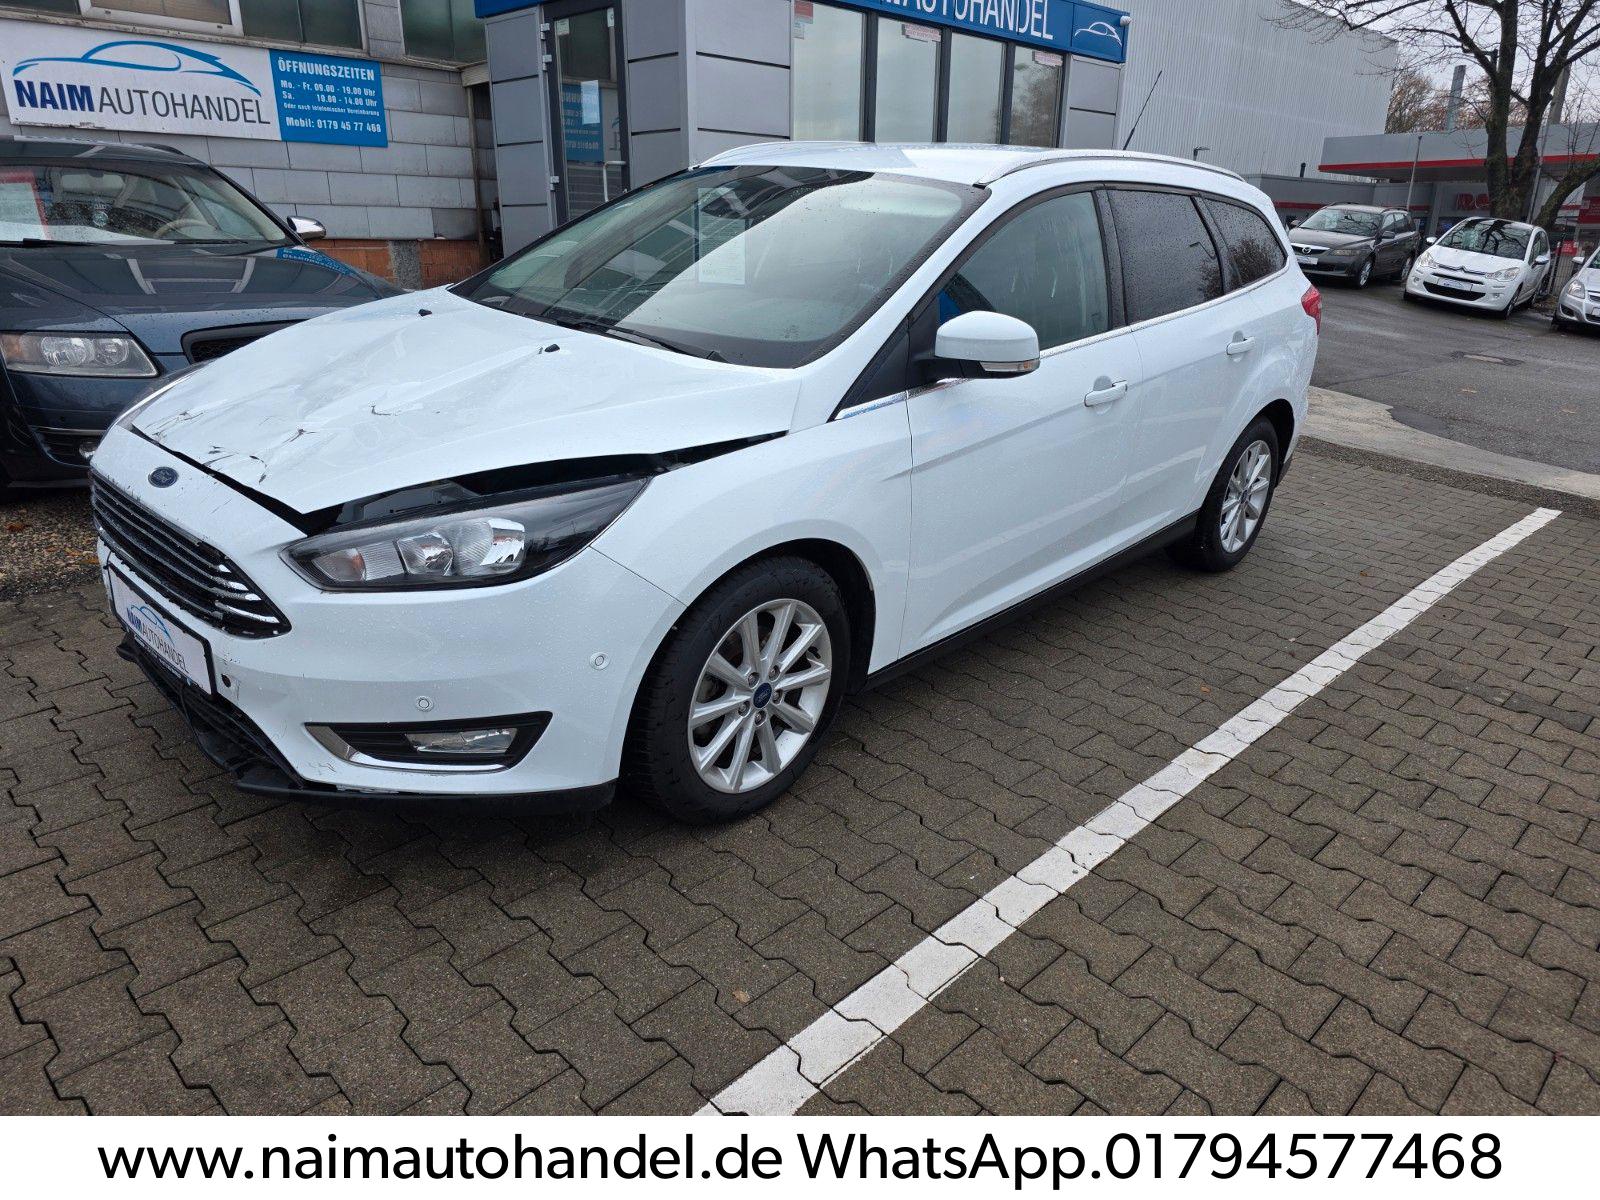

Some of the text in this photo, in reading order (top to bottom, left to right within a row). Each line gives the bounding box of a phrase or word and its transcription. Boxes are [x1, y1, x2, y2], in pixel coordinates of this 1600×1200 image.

[278, 57, 375, 81] ÖFFNUNGSZEITEN
[280, 80, 295, 89] Mo.
[363, 87, 376, 97] Uhr
[13, 79, 271, 125] NAIM AUTOHANDEL
[282, 91, 295, 100] Sa.
[365, 97, 378, 107] Uhr
[286, 116, 315, 128] Mobil:
[317, 119, 338, 131] 0179
[341, 121, 351, 131] 45
[353, 121, 363, 132] 77
